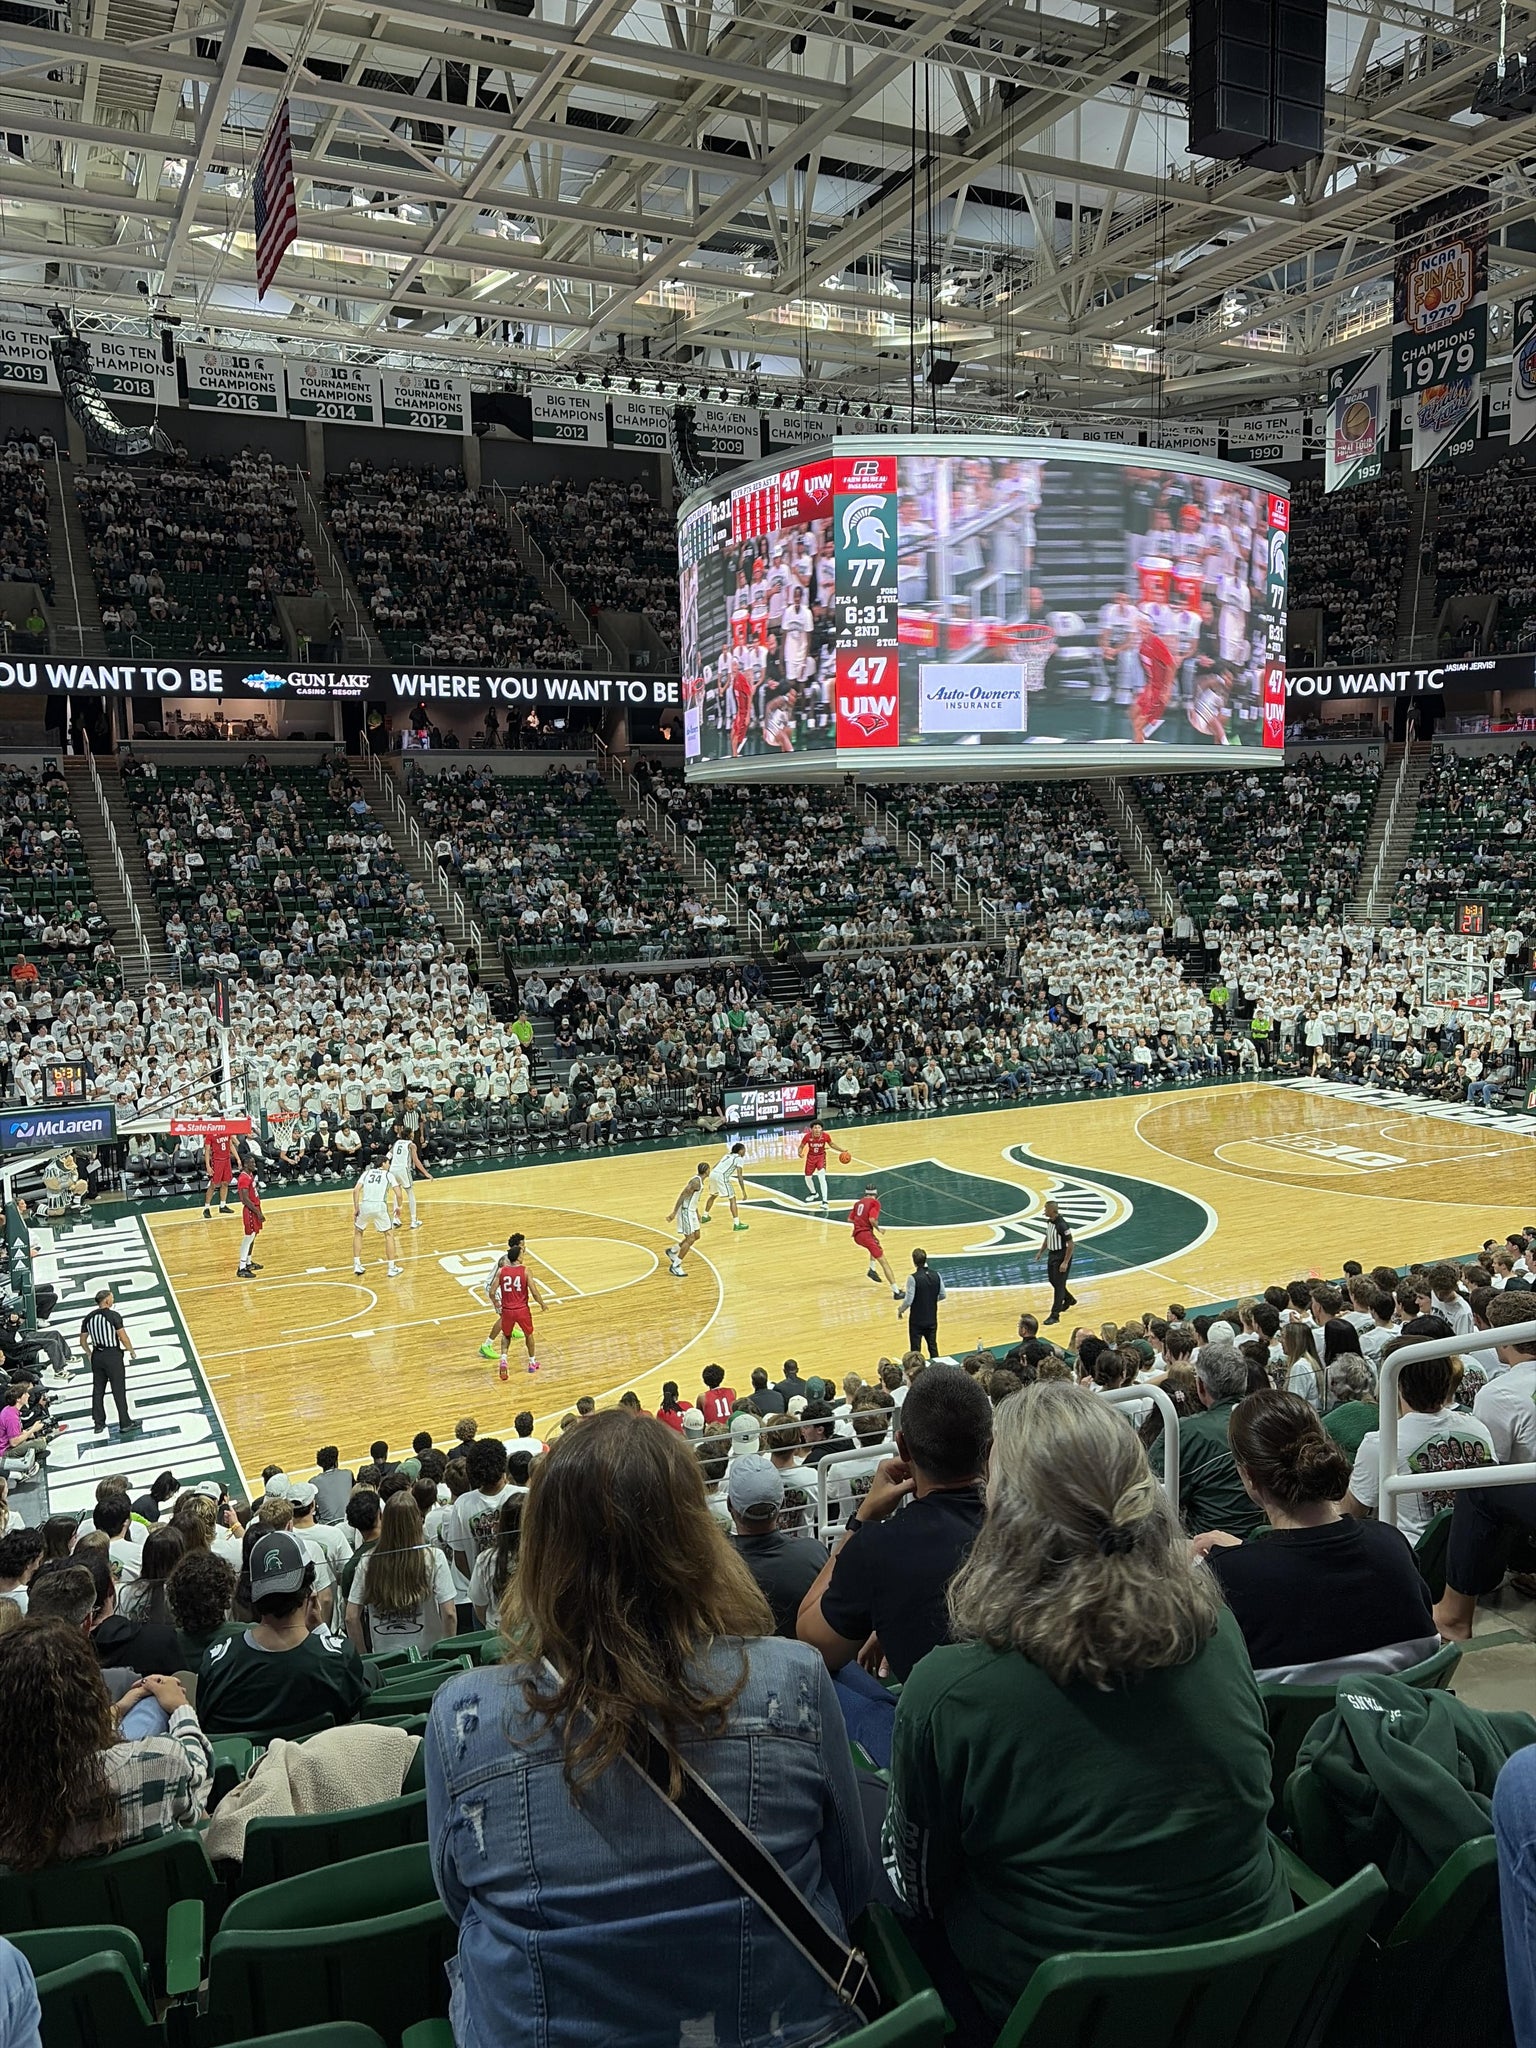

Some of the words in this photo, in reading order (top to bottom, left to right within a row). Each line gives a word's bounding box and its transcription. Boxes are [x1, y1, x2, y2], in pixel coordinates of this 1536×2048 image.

[1421, 249, 1455, 271] NCAA
[1414, 258, 1466, 295] FINAL
[1421, 303, 1456, 324] 1979
[0, 330, 16, 342] IG
[21, 332, 49, 345] TEN
[1401, 328, 1475, 362] CHAMPIONS
[101, 342, 125, 356] BIG
[129, 346, 157, 360] TEN
[3, 365, 43, 380] 2019
[199, 366, 274, 381] TOURNAMENT
[1403, 344, 1474, 389] 1979
[113, 379, 151, 395] 2018
[199, 377, 276, 393] CHAMPIONS
[300, 377, 371, 391] TOURNAMENT
[217, 392, 259, 410] 2016
[300, 388, 373, 403] CHAMPIONS
[395, 387, 461, 402] TOURNAMENT
[547, 395, 566, 406] BIG
[569, 397, 590, 408] TEN
[316, 403, 356, 420] 2014
[395, 397, 463, 413] CHAMPIONS
[628, 403, 646, 414] BIG
[410, 412, 448, 429] 2012
[534, 407, 604, 422] CHAMPIONS
[706, 411, 724, 421] BIG
[727, 413, 746, 423] TEN
[556, 425, 585, 439] 2012
[696, 422, 758, 436] CHAMPIONS
[784, 418, 800, 428] BIG
[804, 420, 823, 430] TEN
[1244, 421, 1262, 431] BIG
[1267, 418, 1288, 428] TEN
[635, 433, 664, 446] 2010
[1083, 431, 1101, 441] BIG
[1104, 430, 1124, 440] TEN
[1149, 437, 1216, 449] CHAMPIONS
[711, 440, 742, 452] 2009
[1249, 446, 1280, 459] 1990
[1448, 439, 1474, 456] 1999
[1358, 463, 1381, 479] 1957
[782, 470, 799, 492] 47
[804, 473, 832, 493] UIW
[712, 498, 731, 524] 6:31
[848, 559, 885, 587] 77
[836, 596, 851, 604] FLS
[852, 595, 858, 604] 4
[882, 595, 898, 603] TOL
[1271, 584, 1284, 610] 77
[845, 605, 888, 624] 6:31
[855, 626, 879, 636] 2ND
[836, 639, 851, 648] FLS
[852, 639, 858, 647] 3
[876, 639, 882, 647] 2
[847, 656, 887, 685] 47
[1445, 664, 1468, 672] JASIAH
[45, 664, 136, 690] WANT
[140, 667, 182, 691] TO
[190, 668, 223, 692] BE
[287, 672, 325, 688] GUN
[328, 673, 370, 688] LAKE
[1269, 669, 1283, 693] 47
[1285, 676, 1332, 696] YOU
[1339, 671, 1410, 694] WANT
[392, 674, 481, 698] WHERE
[485, 676, 538, 699] YOU
[544, 678, 612, 701] WANT
[617, 681, 647, 702] TO
[653, 682, 679, 702] BE
[926, 686, 1020, 700] Auto-Owners
[840, 696, 896, 719] UIW
[945, 701, 1002, 709] INSURANCE
[1461, 915, 1480, 933] 21
[742, 1091, 756, 1104] 77
[757, 1090, 782, 1103] 6:31
[783, 1087, 798, 1100] 47
[36, 1119, 103, 1136] McLaren
[221, 1142, 226, 1151] 8
[396, 1145, 403, 1155] 6
[368, 1174, 382, 1184] 34
[857, 1203, 864, 1216] 0
[503, 1275, 522, 1292] 24
[714, 1397, 731, 1418] 11
